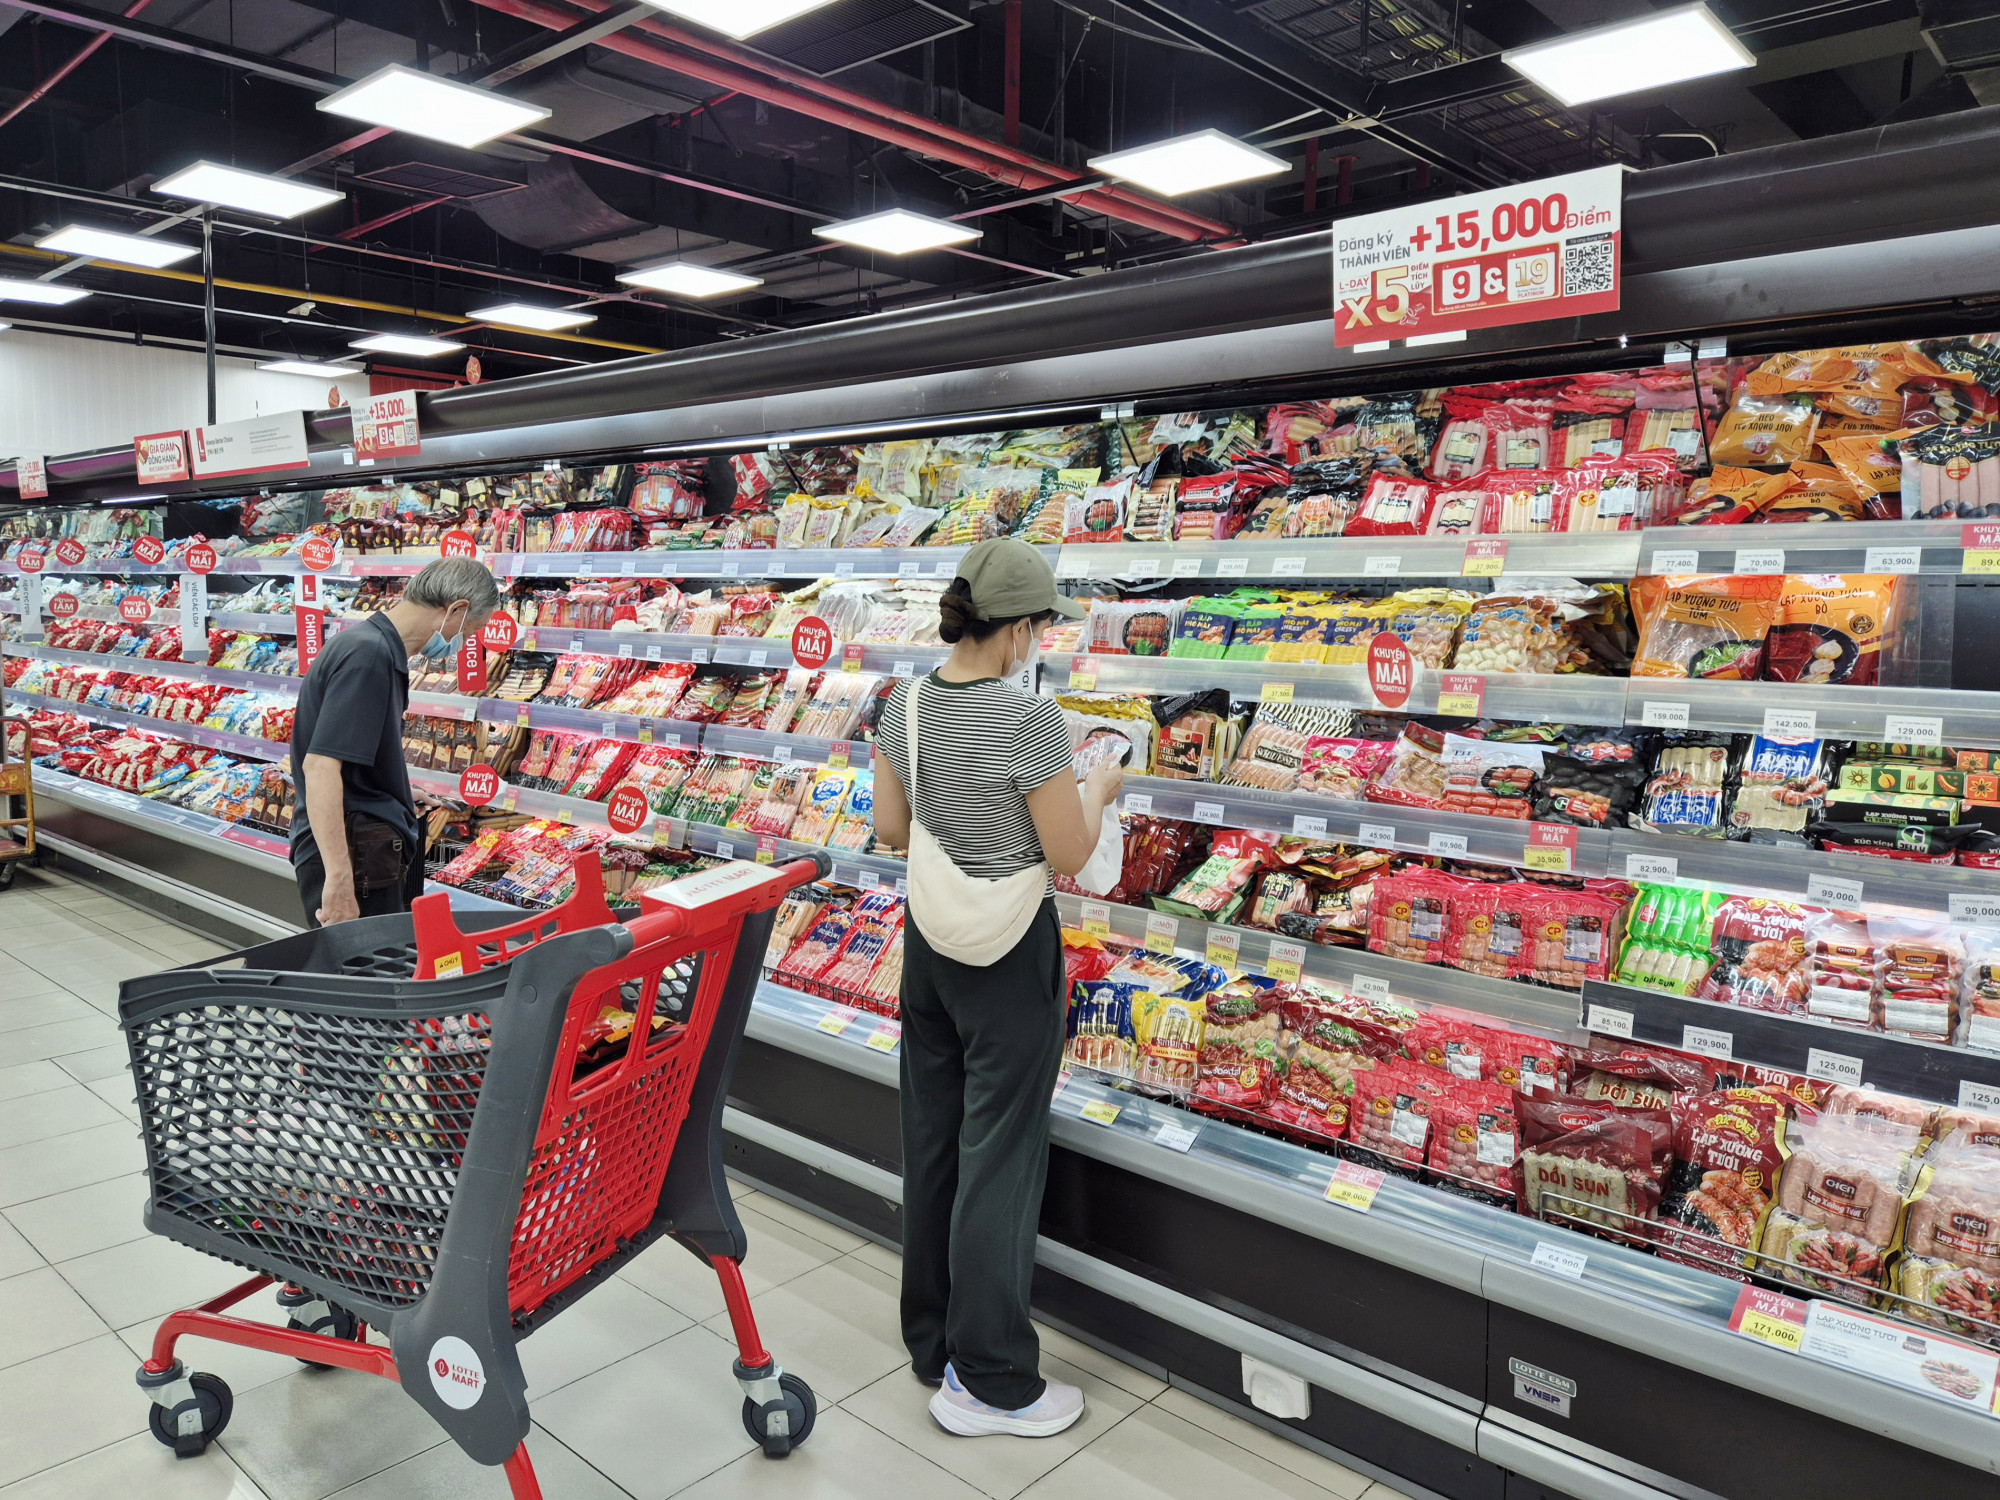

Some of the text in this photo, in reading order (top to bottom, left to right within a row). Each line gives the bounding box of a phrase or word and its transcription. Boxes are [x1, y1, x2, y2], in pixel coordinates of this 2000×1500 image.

[1409, 193, 1612, 252] +15,000 Điểm
[1338, 229, 1393, 252] Đăng ký
[1339, 245, 1411, 269] THÀNH VIÊN
[1339, 277, 1370, 290] L-DAY
[1411, 272, 1428, 281] TÍCH
[1452, 258, 1548, 299] 9 & 19
[369, 398, 405, 421] +15,000
[1580, 494, 1595, 503] CP
[190, 554, 211, 565] MÃI
[1477, 548, 1496, 556] MÃI
[124, 606, 146, 616] MÃI
[1815, 601, 1828, 615] BÒ
[484, 626, 511, 640] MÃI
[797, 634, 826, 655] MÃI
[1376, 659, 1407, 686] MÃI
[1453, 683, 1473, 692] MÃI
[465, 779, 492, 794] MÃI
[612, 802, 641, 822] MÃI
[1538, 825, 1569, 834] KHUYẾN
[1541, 832, 1564, 843] MÃI
[724, 867, 755, 881] MART
[1395, 905, 1408, 916] CP
[1546, 926, 1562, 936] CP
[1752, 925, 1784, 941] TƯƠI
[1637, 1066, 1656, 1075] Deli
[1562, 1116, 1589, 1127] MEAT
[1691, 1127, 1719, 1149] LẠP
[1707, 1148, 1740, 1172] TƯƠI
[1548, 1254, 1579, 1269] 64900
[1752, 1290, 1795, 1309] KHUYẾN
[1755, 1300, 1786, 1317] MÃI
[1872, 1328, 1898, 1343] TƯƠI
[452, 1363, 480, 1379] LOTTE
[1515, 1362, 1571, 1389] LOTTE E&M
[451, 1372, 480, 1389] MART
